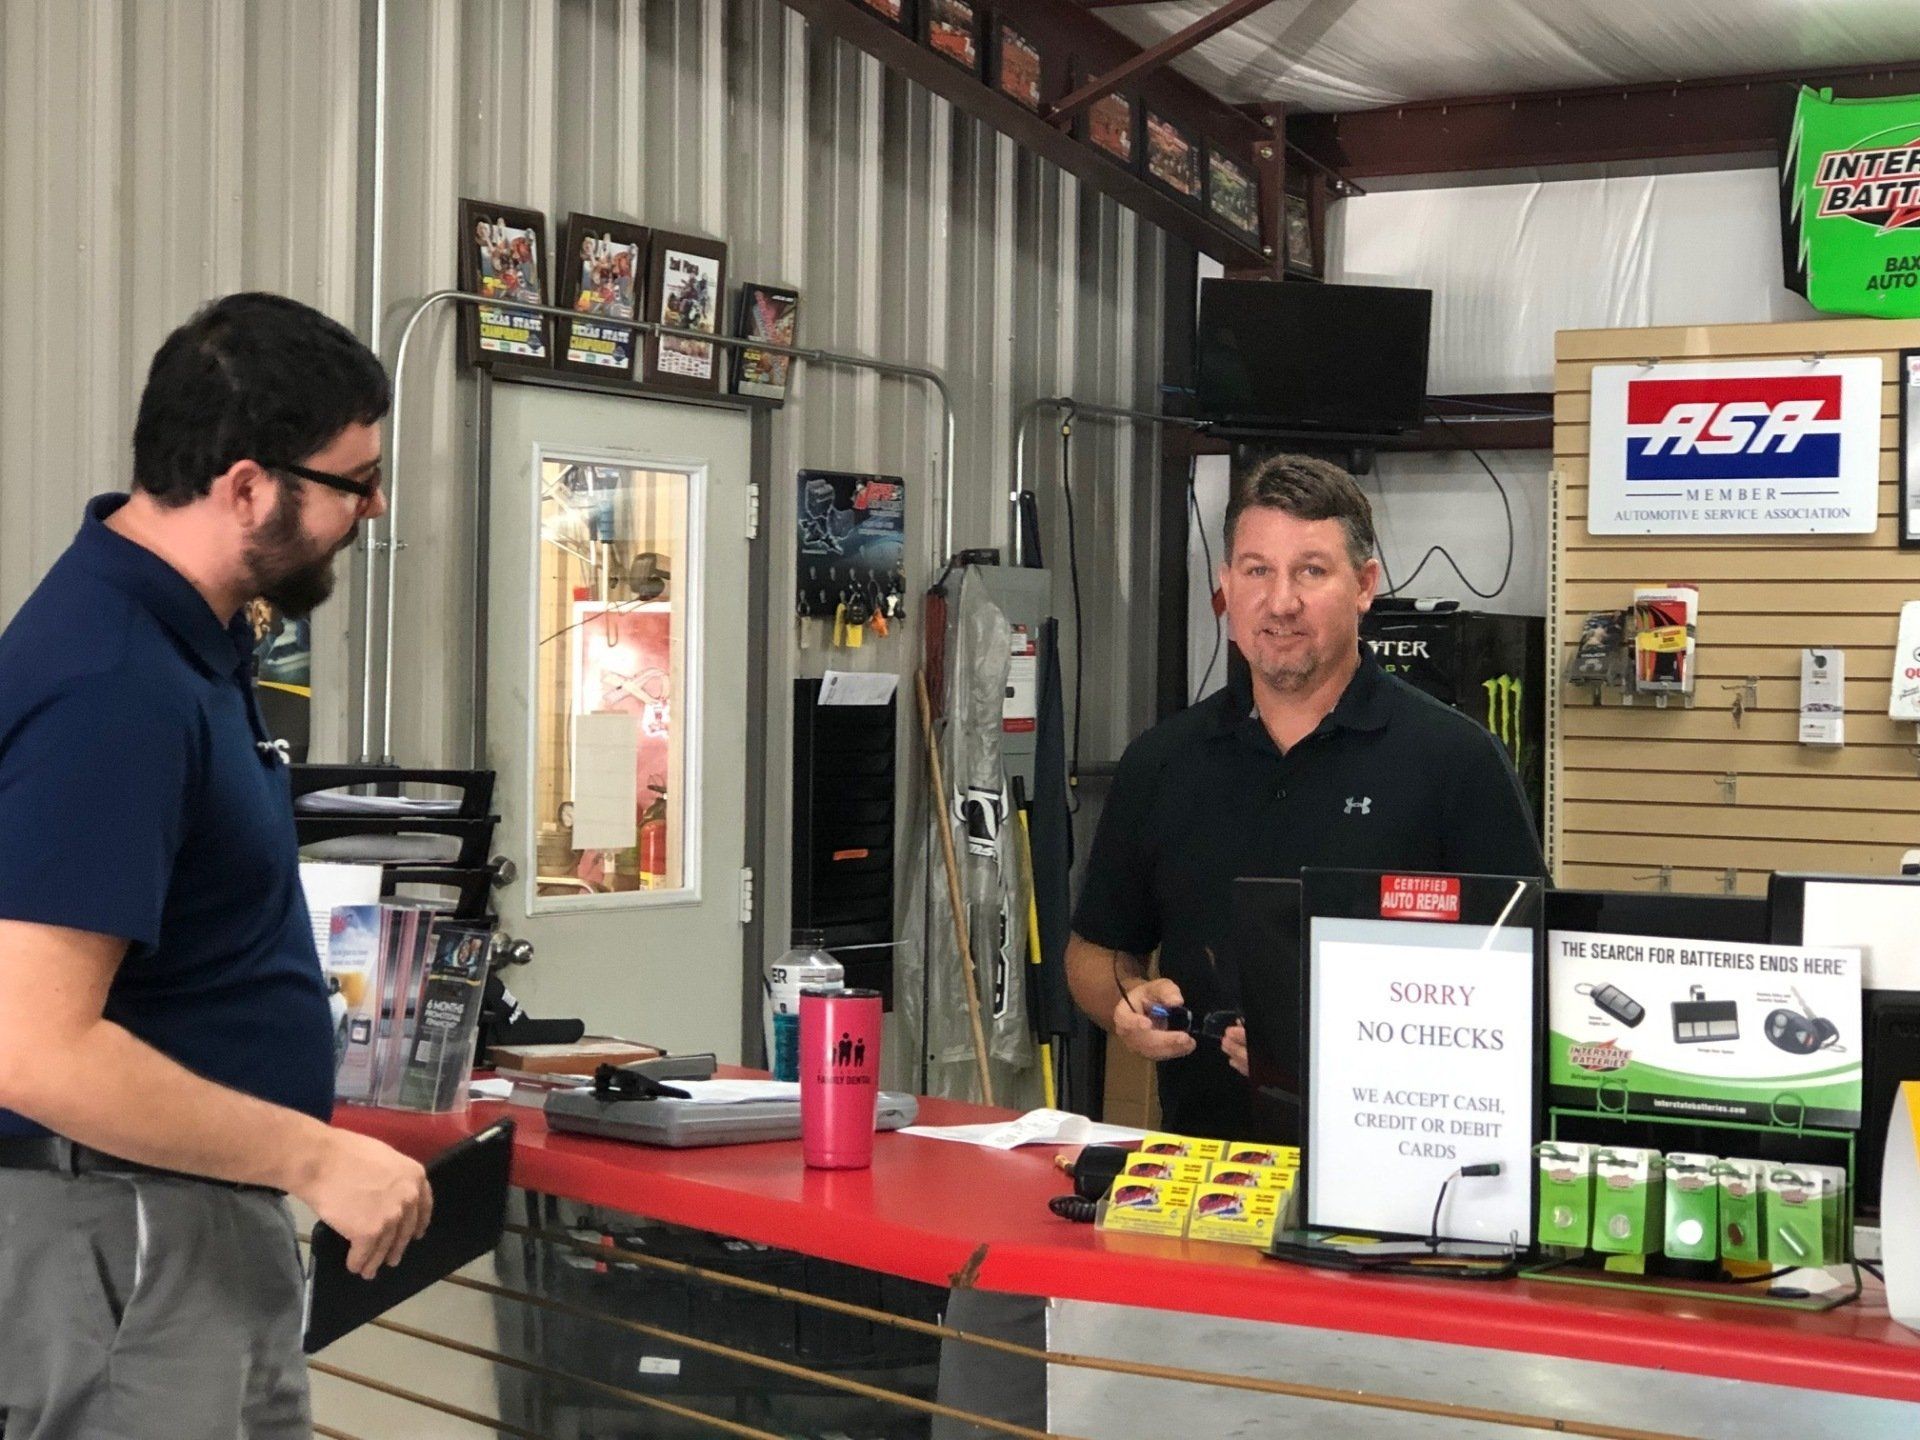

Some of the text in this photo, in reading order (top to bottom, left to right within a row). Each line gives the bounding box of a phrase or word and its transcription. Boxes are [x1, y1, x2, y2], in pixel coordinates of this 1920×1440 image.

[1866, 273, 1918, 291] AUTO
[480, 310, 542, 332] TEXAS STATE
[571, 323, 630, 344] TEXAS STATE
[1640, 400, 1826, 456] ASA
[1686, 488, 1777, 501] MEMBER
[1614, 507, 1851, 521] AUTOMOTIVE SERVICE ASSOCIATION
[1393, 878, 1448, 892] CERTIFIED
[1381, 891, 1458, 911] AUTO REPAIR
[1561, 941, 1587, 958] THE
[1591, 943, 1643, 962] SEARCH
[1649, 947, 1675, 965] FOR
[1680, 950, 1755, 970] BATTERIES
[1760, 955, 1798, 973] ENDS
[1390, 981, 1476, 1007] SORRY
[1357, 1020, 1505, 1051] NO CHECKS
[1569, 1047, 1632, 1060] INTERSTATE
[1571, 1056, 1626, 1068] BATTERIES
[1352, 1087, 1505, 1115] WE ACCEPT CASH,
[1653, 1098, 1747, 1115] interstatebatteries.com
[1354, 1112, 1502, 1138] CREDIT OR DEBIT
[1398, 1141, 1457, 1159] CARDS
